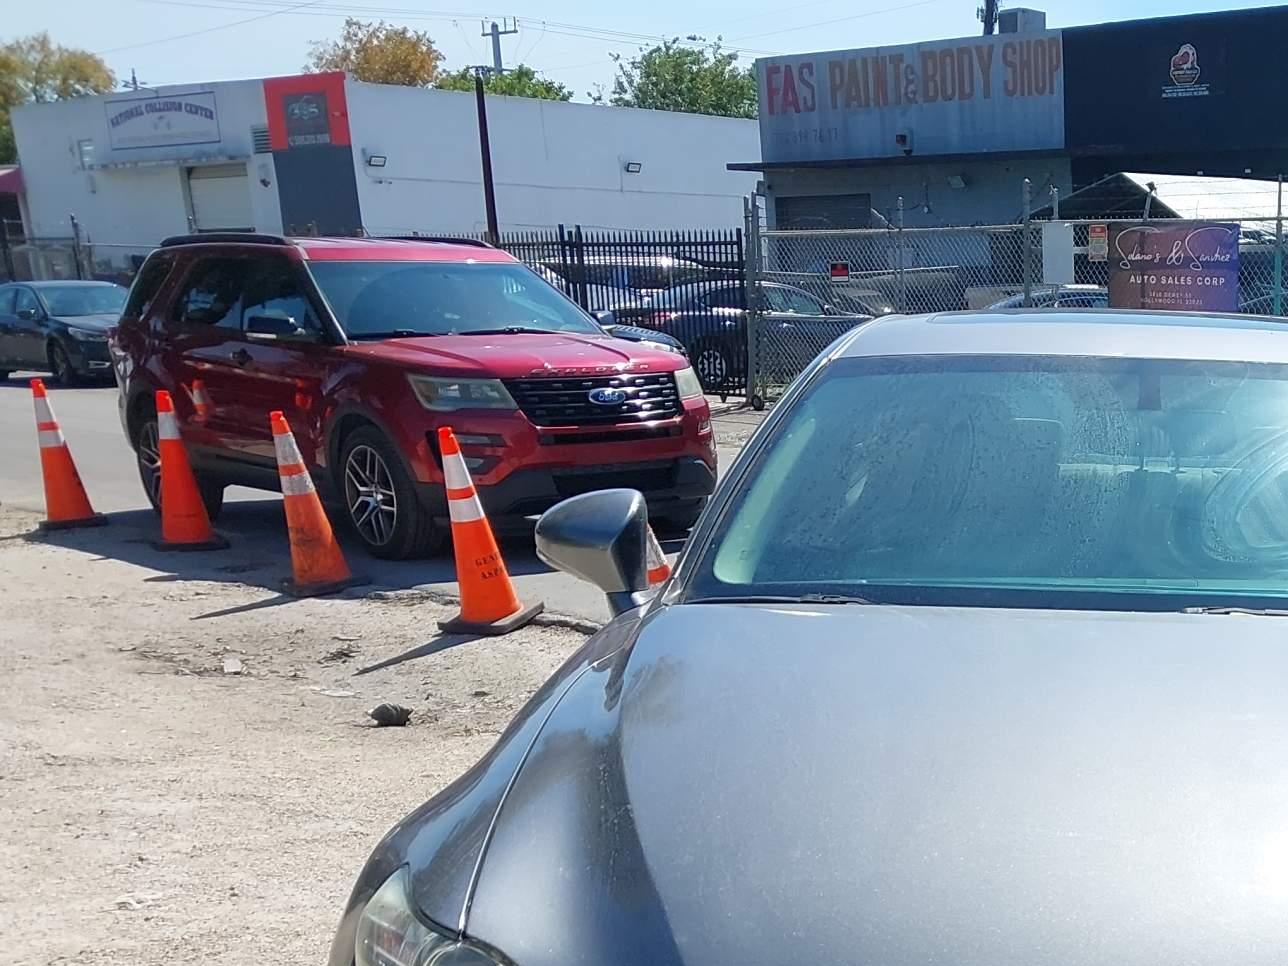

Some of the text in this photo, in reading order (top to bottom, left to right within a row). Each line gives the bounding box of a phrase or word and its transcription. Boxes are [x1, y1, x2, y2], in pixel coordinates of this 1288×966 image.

[765, 62, 816, 116] FAS
[829, 53, 904, 110] PAINT
[920, 44, 995, 103] BODY
[1002, 37, 1061, 97] SHOP
[110, 101, 214, 128] NATIONAL COLLISION CENTER
[1167, 241, 1183, 265] &
[1185, 226, 1232, 271] Sanchez
[1129, 275, 1225, 286] AUTO SALES CORP
